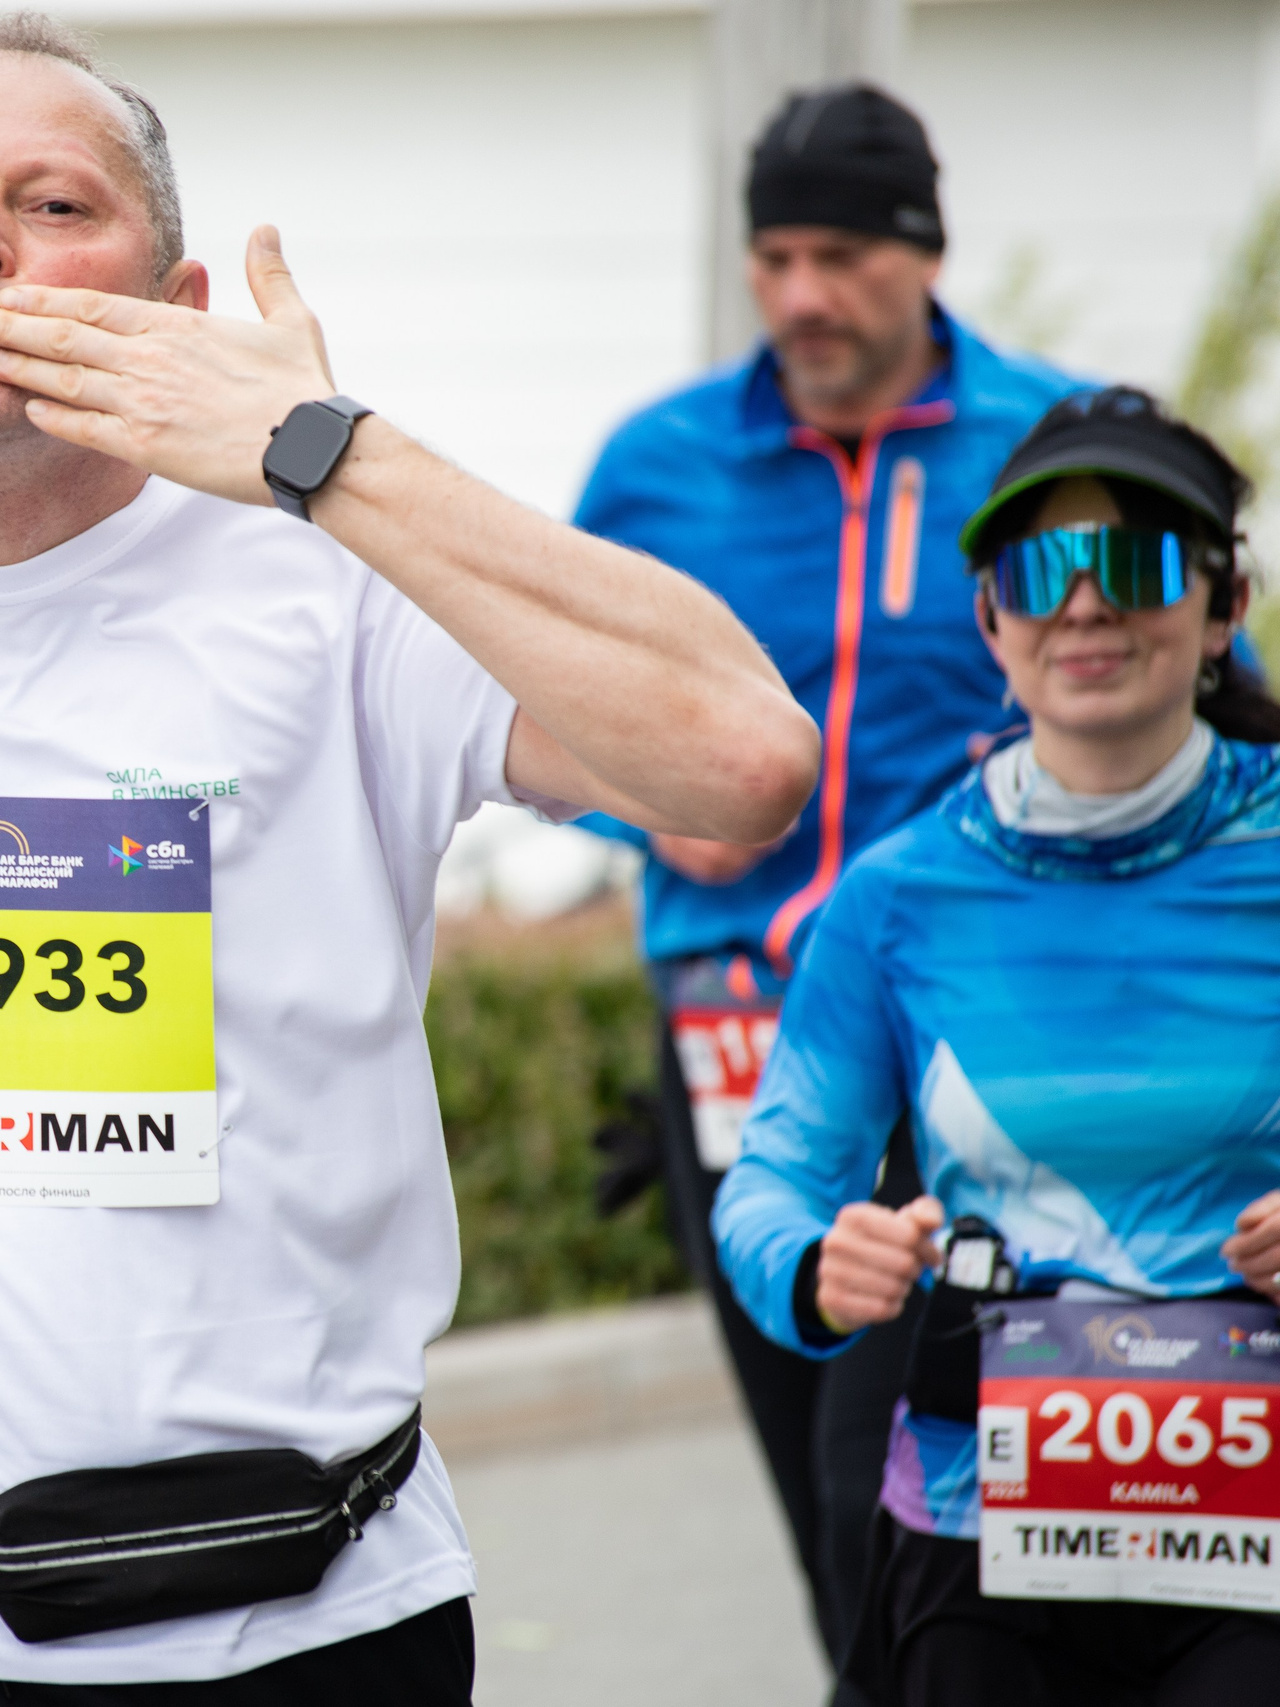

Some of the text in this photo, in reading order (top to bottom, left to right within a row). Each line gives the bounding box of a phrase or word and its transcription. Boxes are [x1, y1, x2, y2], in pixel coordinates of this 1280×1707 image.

[106, 768, 162, 784] СИЛА
[0, 855, 84, 867] АК БАРС БАНК
[0, 865, 73, 878] КАЗАНСКИЙ
[0, 878, 58, 889] МАРАФОН
[0, 1187, 36, 1197] после
[39, 1187, 90, 1199] финиша
[1038, 1390, 1272, 1469] 2065
[989, 1427, 1012, 1461] E
[1110, 1481, 1201, 1505] KAMILA
